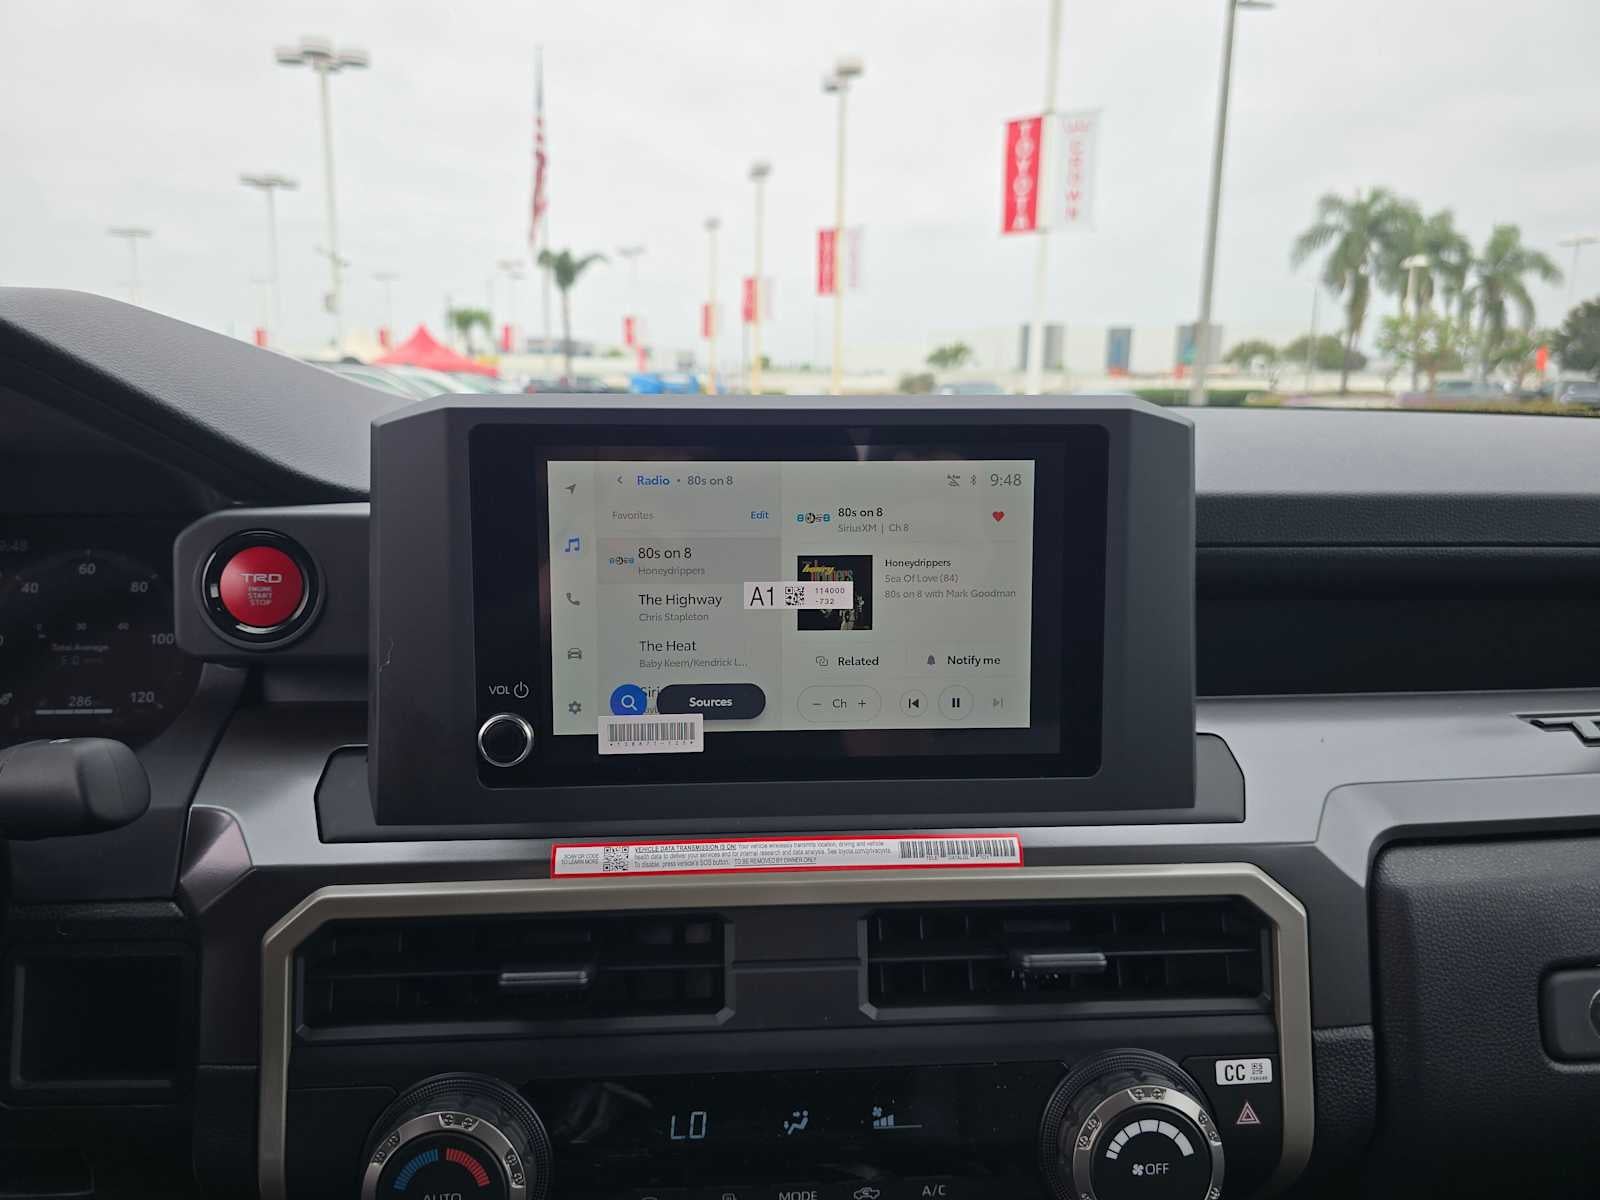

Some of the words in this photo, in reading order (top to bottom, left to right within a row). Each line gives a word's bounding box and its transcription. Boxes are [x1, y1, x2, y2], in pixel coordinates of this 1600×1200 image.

[637, 475, 670, 486] Radio
[687, 475, 707, 486] 80s
[709, 477, 724, 486] on
[726, 475, 734, 486] 8
[990, 473, 1022, 487] 9:48
[612, 511, 654, 520] Favorites
[750, 510, 769, 520] Edit
[838, 507, 857, 518] 80s
[859, 509, 873, 518] on
[876, 507, 884, 518] 8
[838, 523, 877, 533] SiriusXM
[888, 523, 902, 533] Ch
[902, 523, 909, 533] 8
[638, 547, 661, 560] 80s
[664, 549, 681, 560] on
[684, 547, 692, 560] 8
[78, 563, 96, 575] 60
[885, 558, 951, 569] Honeydrippers
[638, 566, 706, 577] Honeydrippers
[240, 573, 283, 584] TRD
[885, 574, 902, 583] Sea
[904, 574, 915, 583] Of
[917, 574, 938, 583] Love
[939, 573, 959, 584] (84)
[20, 582, 39, 594] 40
[130, 581, 149, 593] 80
[750, 586, 775, 606] A1
[884, 590, 900, 599] 80s
[902, 591, 915, 599] on
[926, 589, 944, 599] with
[947, 589, 968, 598] Mark
[970, 588, 1016, 598] Goodman
[639, 594, 662, 606] The
[667, 594, 722, 608] Highway
[639, 612, 662, 622] Chris
[665, 612, 709, 623] Stapleton
[151, 633, 174, 645] 100
[640, 640, 663, 652] The
[667, 640, 697, 652] Heat
[640, 659, 661, 669] Baby
[838, 656, 879, 666] Related
[947, 656, 981, 667] Notify
[983, 658, 1001, 666] me
[489, 685, 511, 696] VOL
[68, 696, 93, 707] 286
[130, 691, 155, 703] 120
[689, 697, 733, 708] Sources
[832, 699, 847, 708] Ch
[1224, 1064, 1246, 1081] CC
[1145, 1162, 1170, 1175] OFF
[778, 1191, 817, 1200] MODE
[922, 1184, 947, 1197] A/C
